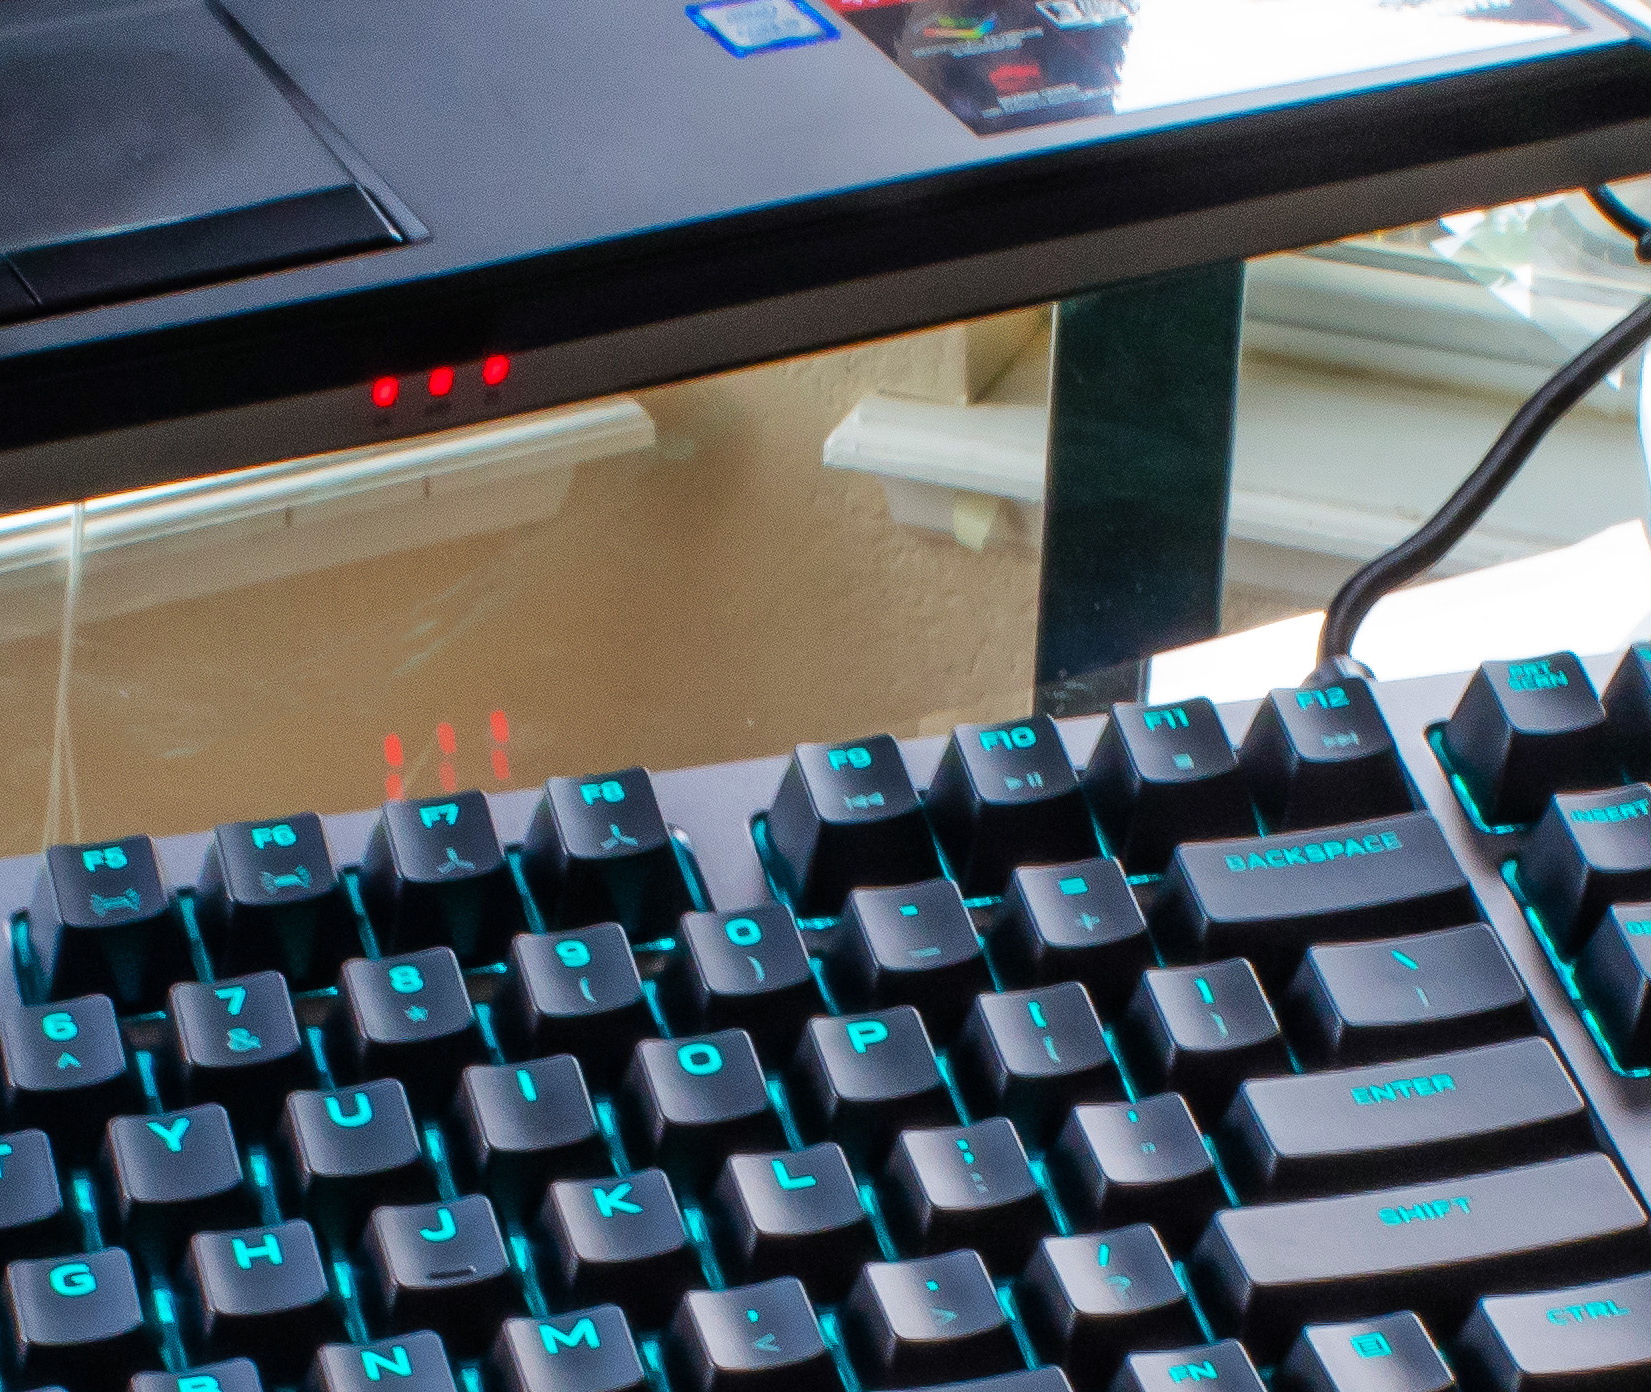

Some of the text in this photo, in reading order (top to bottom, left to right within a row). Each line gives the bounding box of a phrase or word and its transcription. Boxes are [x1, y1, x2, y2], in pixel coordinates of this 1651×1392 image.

[1295, 686, 1350, 710] F12
[1143, 707, 1190, 731] F11
[979, 726, 1037, 751] F10
[82, 846, 129, 873] F5
[1225, 831, 1403, 872] BACKSPACE
[724, 917, 762, 947] 0
[554, 939, 591, 968] 9
[388, 964, 425, 994] 8
[215, 985, 247, 1016] 7
[42, 1012, 79, 1042] 6
[845, 1020, 889, 1054] P
[676, 1042, 724, 1076] O
[516, 1069, 538, 1102] I
[1351, 1073, 1455, 1105] ENTER
[324, 1092, 373, 1128] U
[147, 1117, 191, 1153] Y
[771, 1159, 817, 1191] L
[592, 1182, 643, 1218] K
[1378, 1196, 1469, 1226] SHIFT
[419, 1207, 457, 1242] J
[231, 1233, 284, 1270] H
[49, 1262, 97, 1297] G
[1546, 1299, 1629, 1325] CTRL
[538, 1317, 601, 1355] M
[360, 1345, 413, 1381] N
[1168, 1360, 1218, 1383] FN
